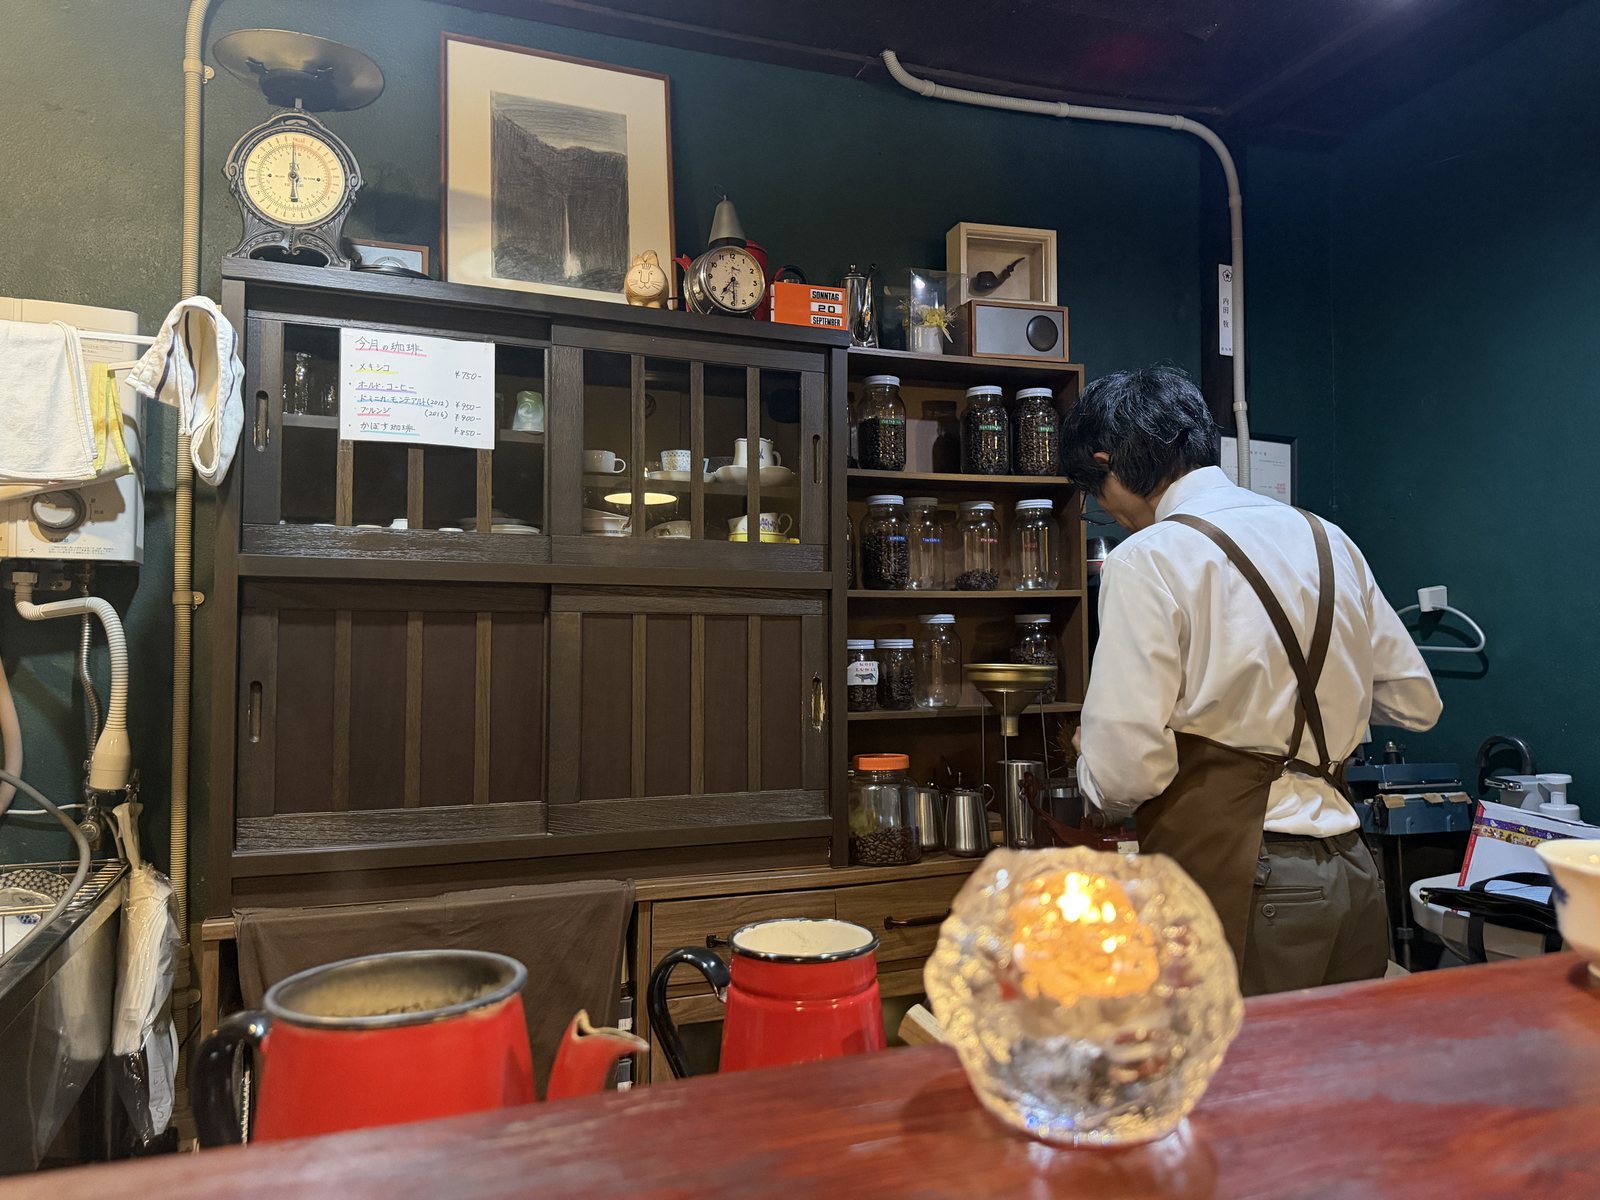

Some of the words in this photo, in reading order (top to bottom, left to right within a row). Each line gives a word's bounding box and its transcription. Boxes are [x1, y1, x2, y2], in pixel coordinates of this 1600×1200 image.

[811, 290, 840, 301] SONNTAG
[818, 304, 836, 314] 20
[812, 316, 841, 326] SEPTEMBER
[355, 336, 423, 355] 今月の珈琲
[359, 362, 390, 372] メキシコ
